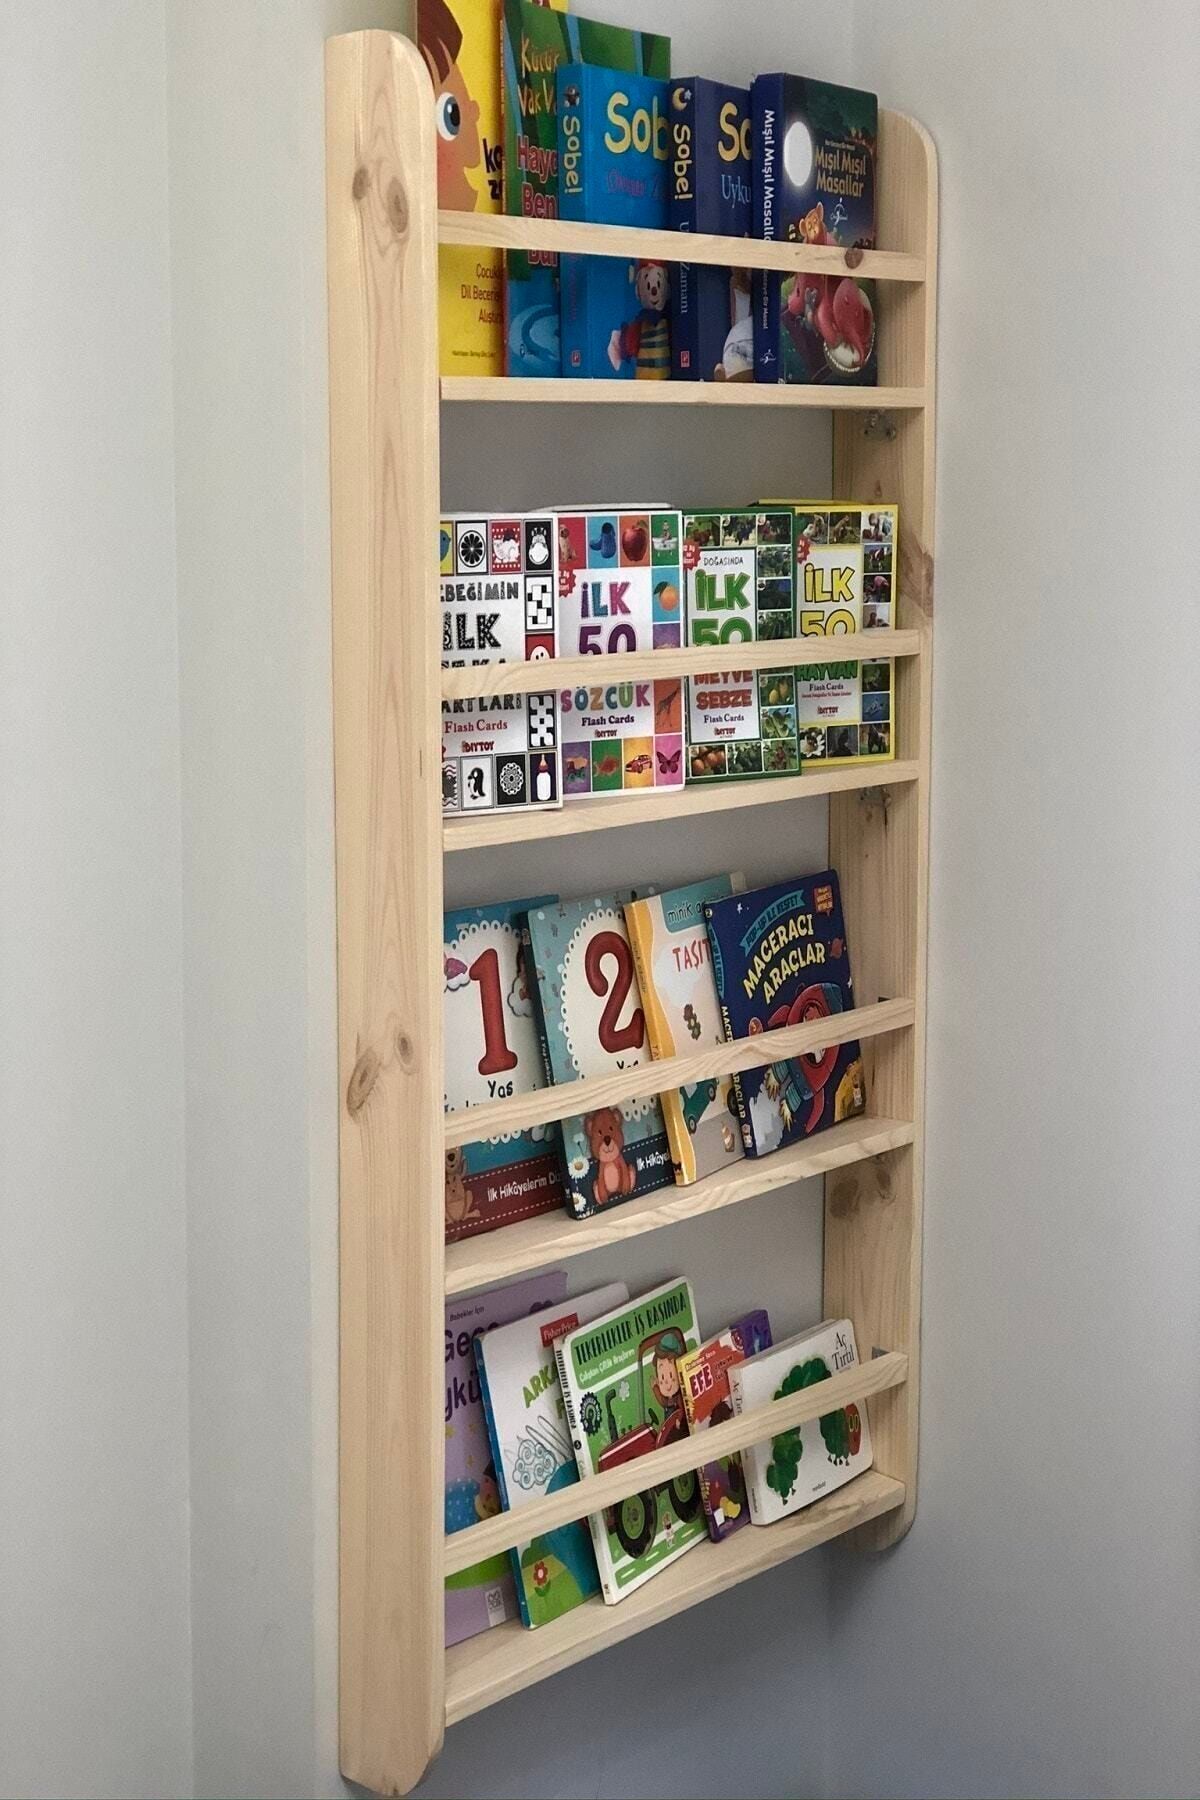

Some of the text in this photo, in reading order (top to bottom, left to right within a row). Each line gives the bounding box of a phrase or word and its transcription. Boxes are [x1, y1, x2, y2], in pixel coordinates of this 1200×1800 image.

[562, 114, 583, 195] Sobe!
[673, 122, 693, 201] Sobe!
[814, 145, 841, 175] Mışıl
[841, 151, 867, 180] Mışıl
[816, 169, 865, 198] Masallar
[694, 568, 752, 612] İLK
[804, 562, 856, 604] İLK
[581, 581, 632, 619] İLK
[442, 610, 502, 652] İLK
[578, 622, 638, 656] 50
[691, 616, 753, 647] 50
[800, 608, 856, 637] 50
[560, 681, 651, 713] SÖZCÜK
[695, 688, 753, 711] SEBZE
[809, 682, 844, 692] Flash Cards
[444, 718, 508, 734] Flash Cards
[581, 714, 635, 727] Flash Cards
[703, 713, 745, 724] Flash Cards
[667, 901, 693, 923] minik
[742, 913, 815, 1000] MACERACI
[762, 942, 826, 1005] ARAÇLAR
[584, 930, 645, 1054] 2
[468, 947, 519, 1076] 1
[831, 1343, 855, 1371] Tırtıl
[834, 1331, 848, 1351] Aç
